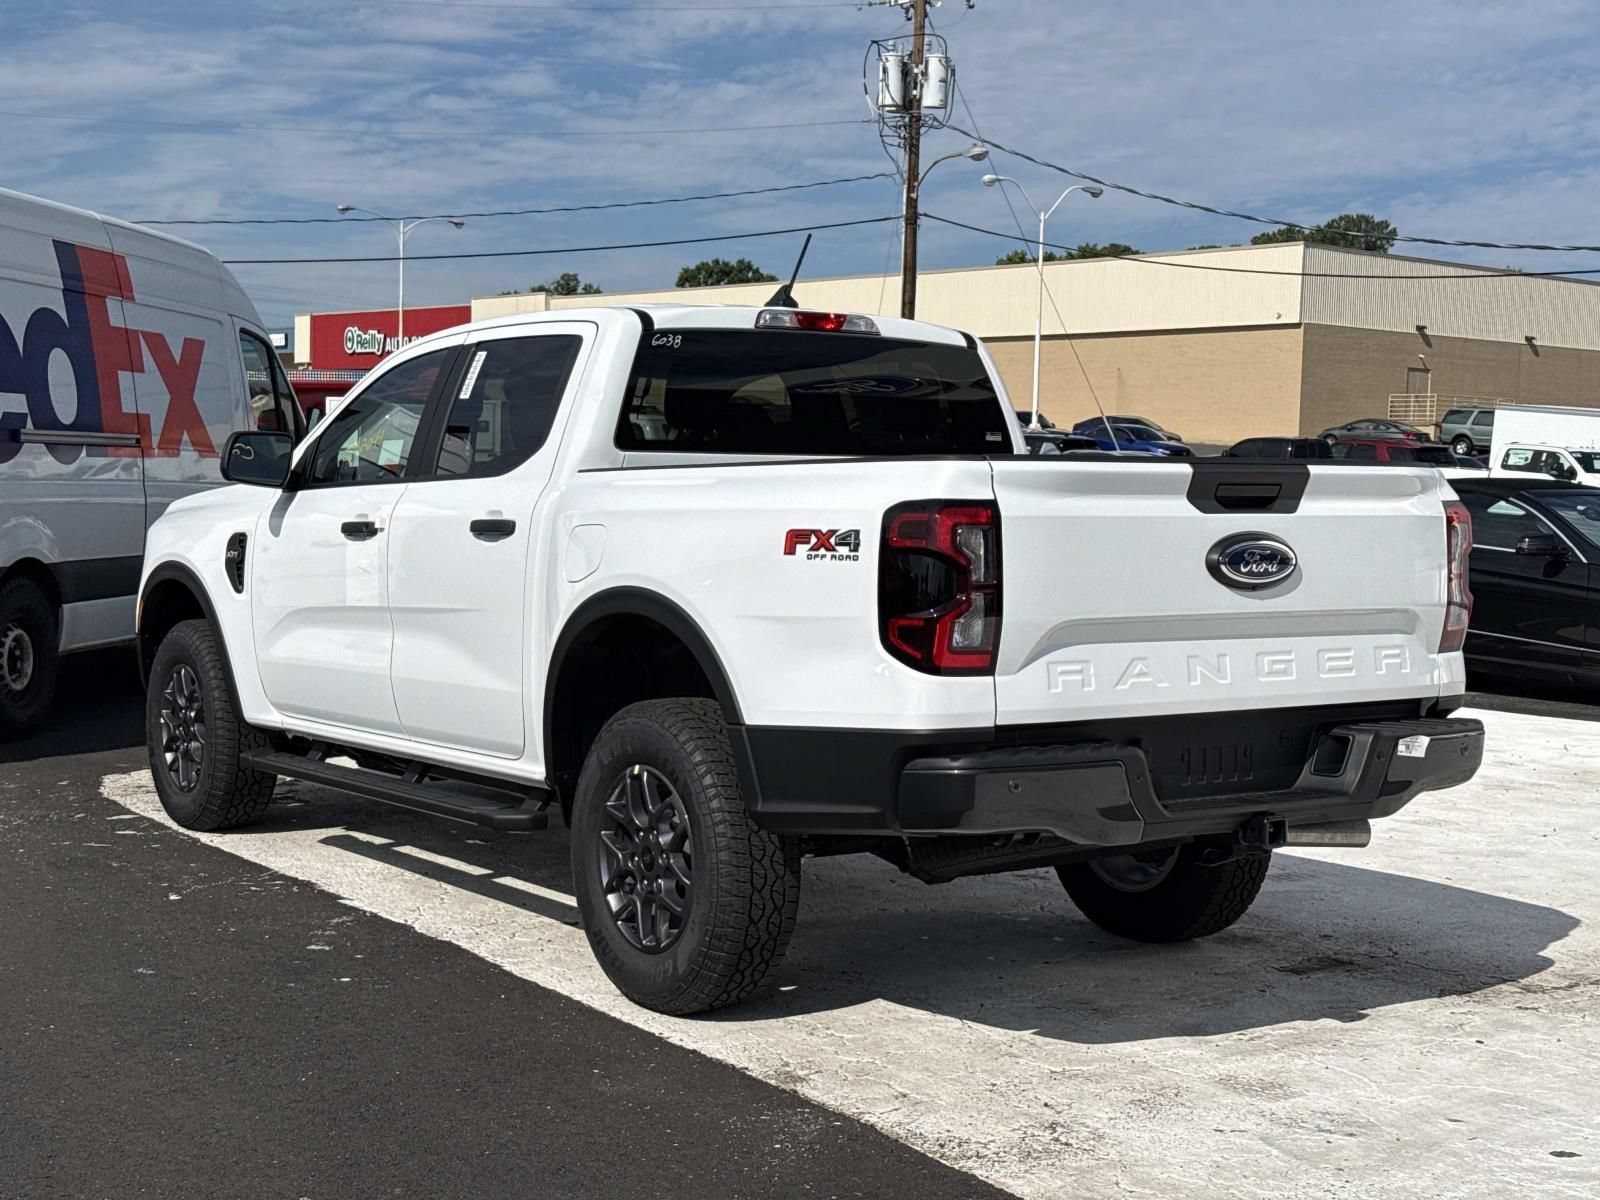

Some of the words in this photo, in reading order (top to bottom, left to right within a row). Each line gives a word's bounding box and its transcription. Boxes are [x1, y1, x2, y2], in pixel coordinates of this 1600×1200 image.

[344, 327, 384, 355] O'Reilly
[652, 334, 682, 348] 6038
[784, 529, 861, 555] FX4
[1240, 549, 1280, 572] Ford
[1046, 645, 1411, 693] RANGER
